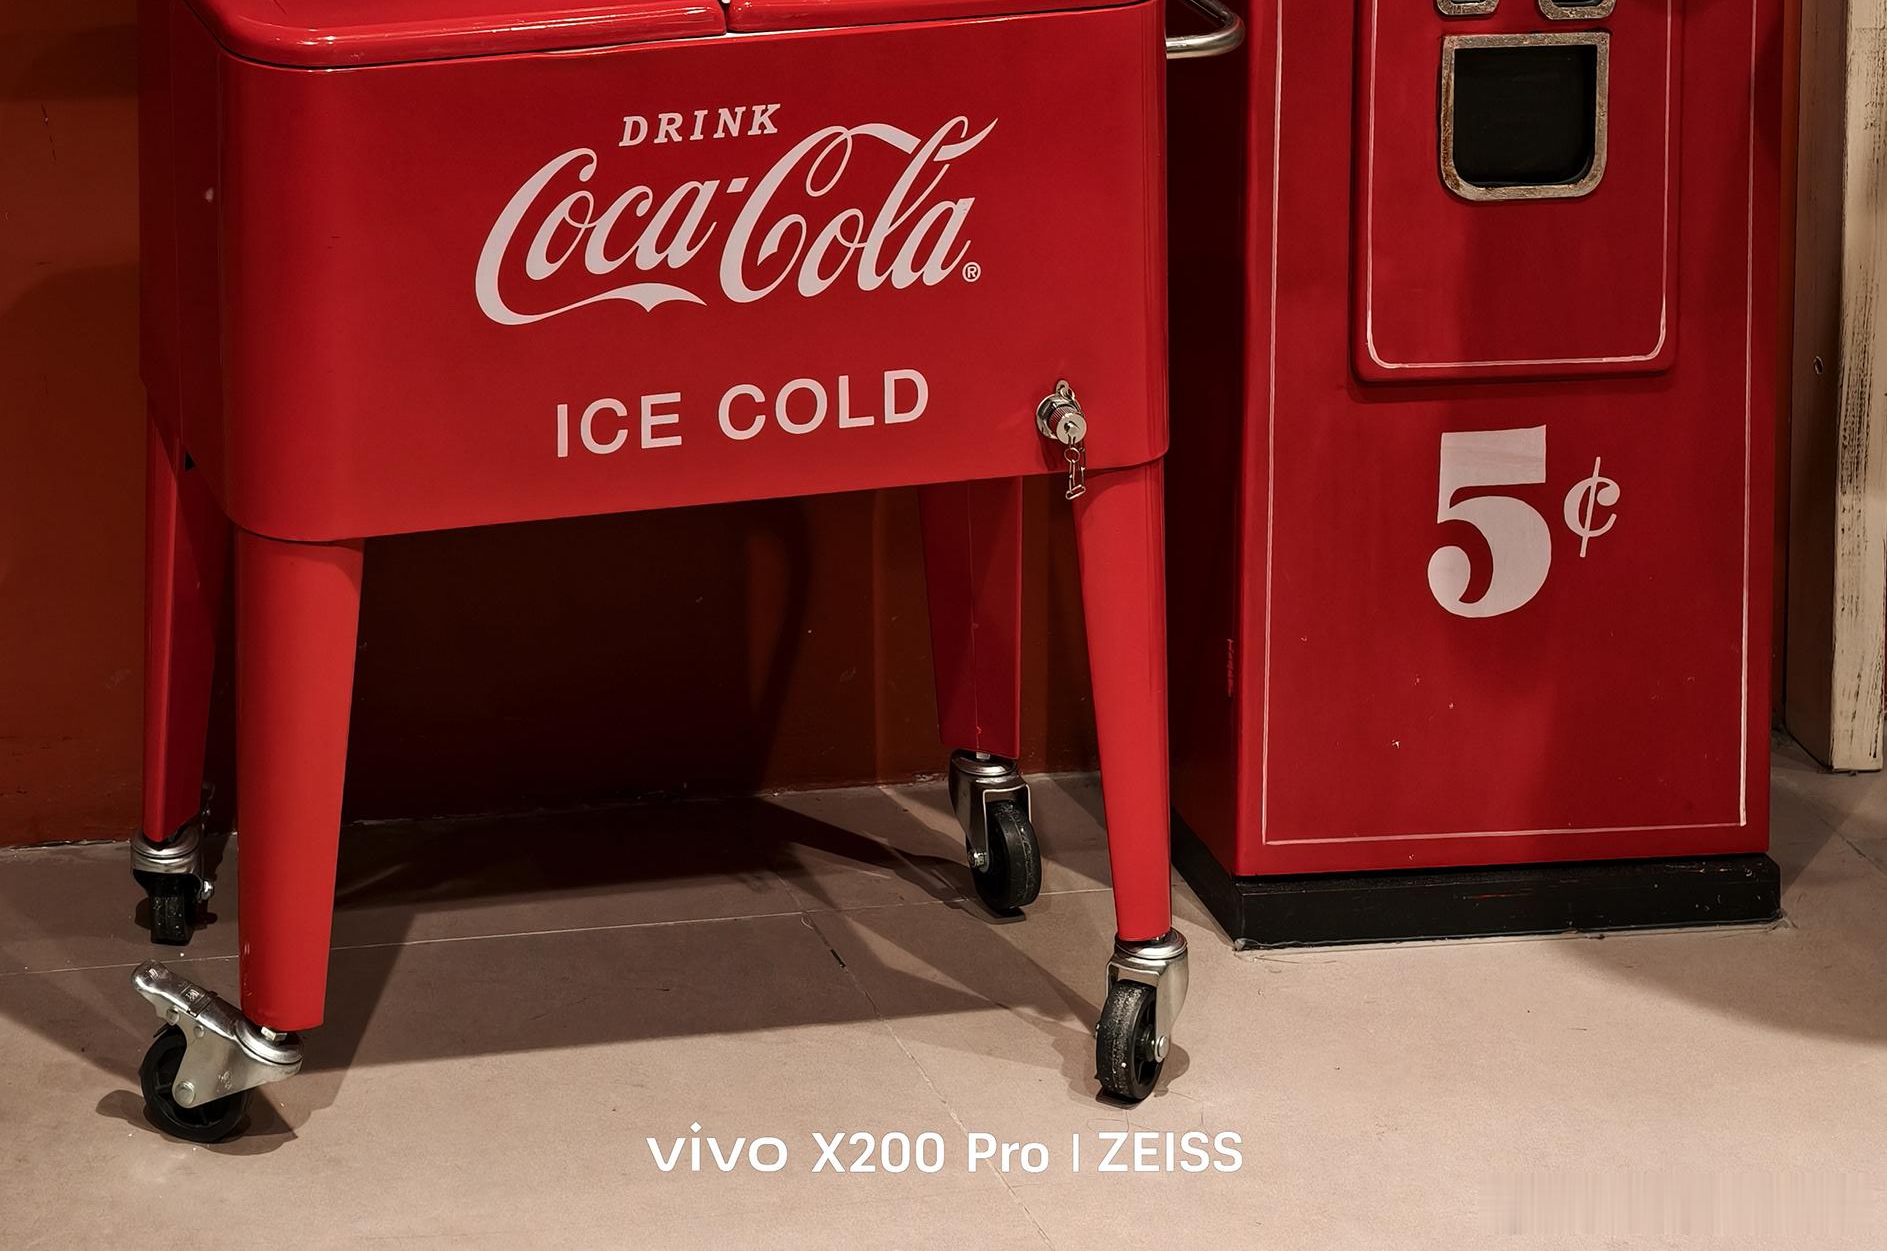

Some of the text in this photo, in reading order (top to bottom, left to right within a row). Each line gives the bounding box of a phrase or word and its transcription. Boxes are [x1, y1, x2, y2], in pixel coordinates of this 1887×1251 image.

[618, 103, 781, 147] DRINK
[556, 368, 929, 458] ICE COLD
[1427, 424, 1621, 618] 5¢
